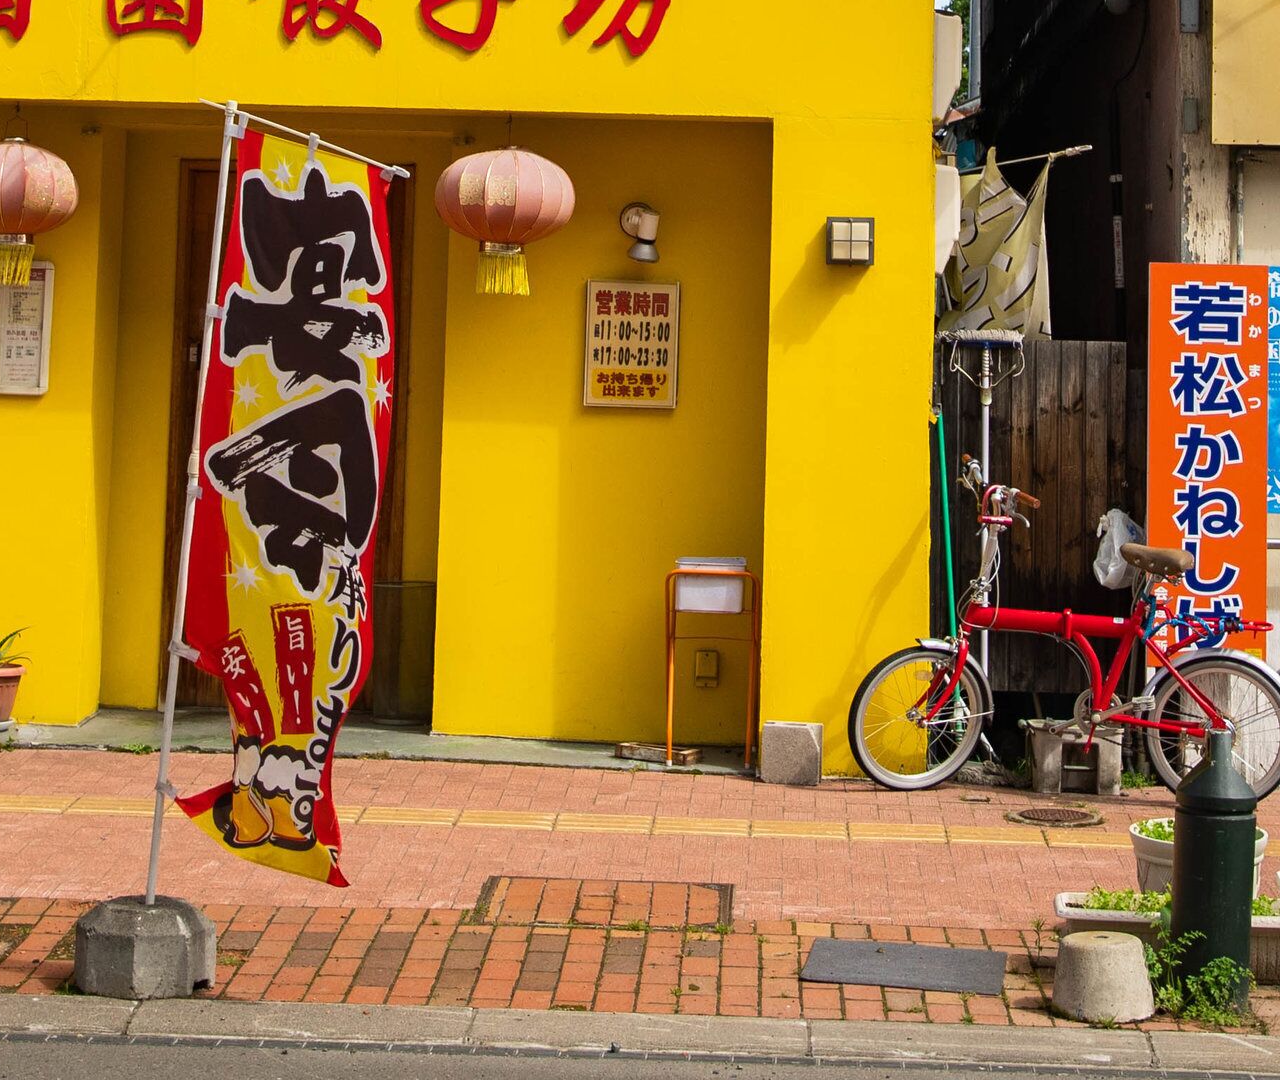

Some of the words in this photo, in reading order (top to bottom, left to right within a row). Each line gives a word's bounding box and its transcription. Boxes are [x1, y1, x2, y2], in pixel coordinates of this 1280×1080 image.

[595, 290, 670, 317] 営業時間
[206, 160, 390, 595] 宴会
[597, 372, 667, 386] お持ち帰り
[602, 385, 660, 398] 出来ます
